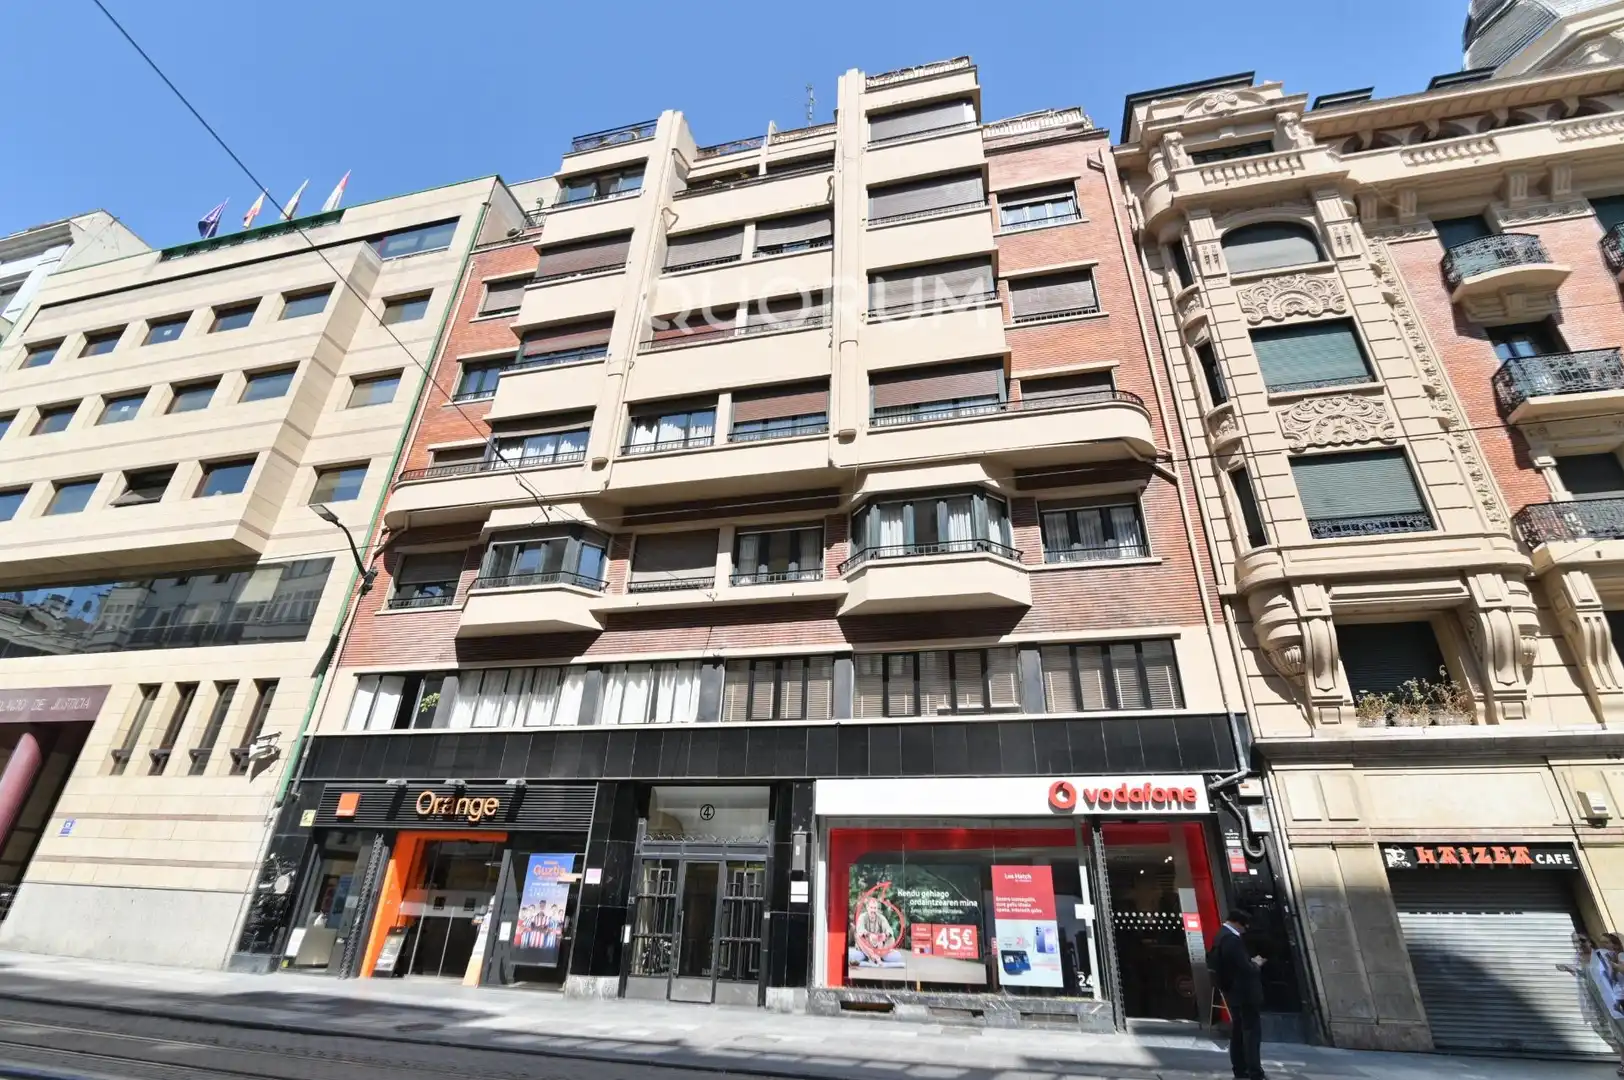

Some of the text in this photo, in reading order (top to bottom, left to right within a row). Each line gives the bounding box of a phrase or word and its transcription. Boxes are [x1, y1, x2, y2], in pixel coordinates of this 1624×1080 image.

[1083, 782, 1198, 804] vodafone
[415, 790, 500, 821] Orange
[702, 804, 713, 819] 4
[1535, 852, 1573, 865] CAFE
[897, 888, 950, 899] Kendu gehiago
[960, 899, 978, 907] mina
[935, 927, 973, 950] 45€
